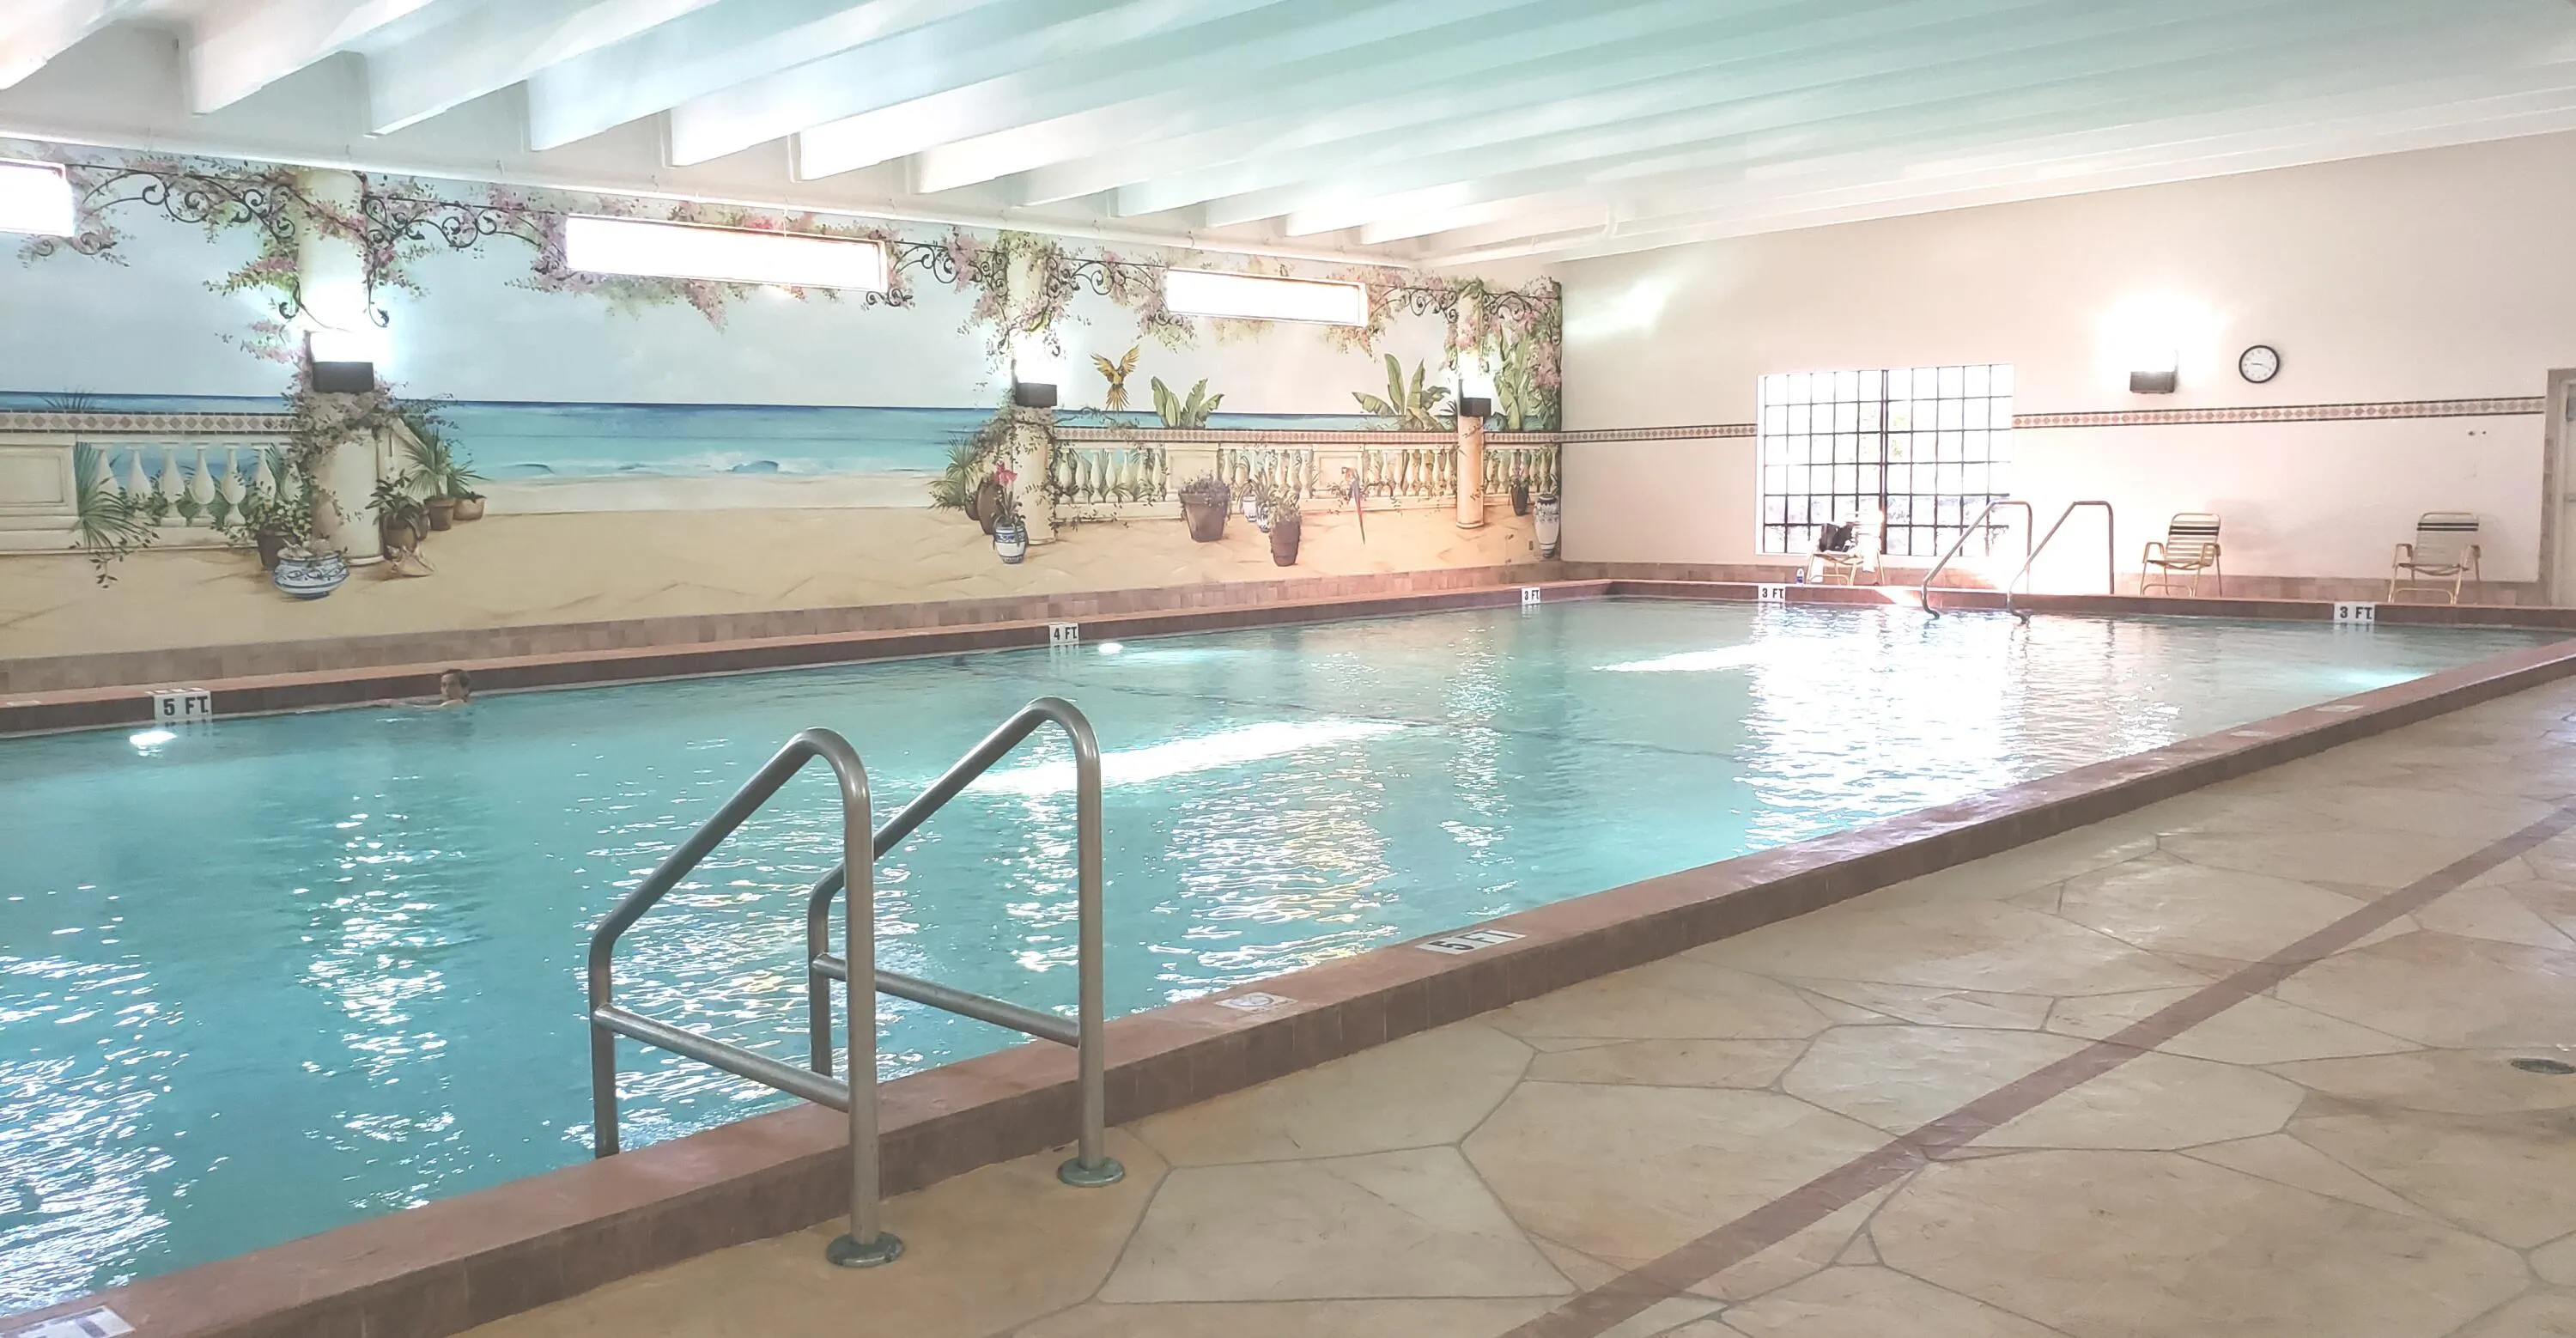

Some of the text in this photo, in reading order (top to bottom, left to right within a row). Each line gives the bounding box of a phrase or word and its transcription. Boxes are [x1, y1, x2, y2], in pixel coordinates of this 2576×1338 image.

[1524, 591, 1528, 600] 3
[1762, 588, 1768, 598] 3
[2340, 606, 2348, 618] 3
[1054, 627, 1060, 641] 4
[163, 697, 175, 716] 5
[1428, 941, 1474, 950] 5
